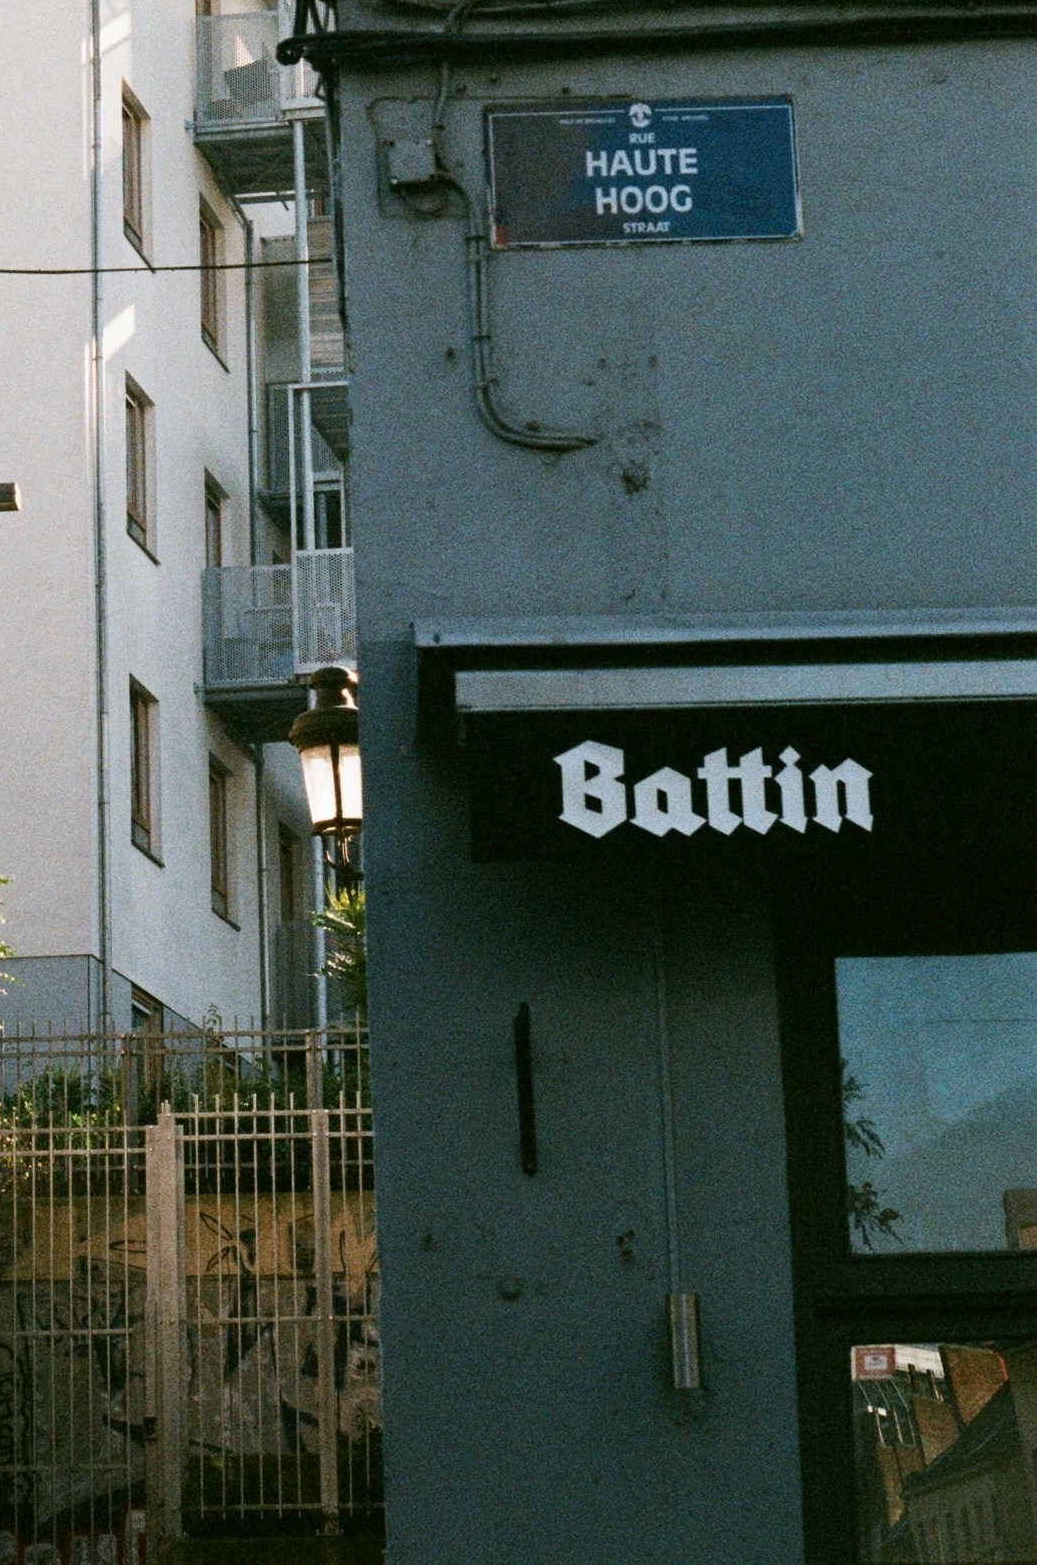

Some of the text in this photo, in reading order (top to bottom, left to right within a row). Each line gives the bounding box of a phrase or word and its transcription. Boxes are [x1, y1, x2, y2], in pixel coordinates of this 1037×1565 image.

[629, 133, 655, 144] RUE
[585, 148, 698, 177] HAUTE
[595, 185, 693, 215] HOOG
[623, 222, 671, 234] STRAAT
[553, 740, 874, 838] Battin
